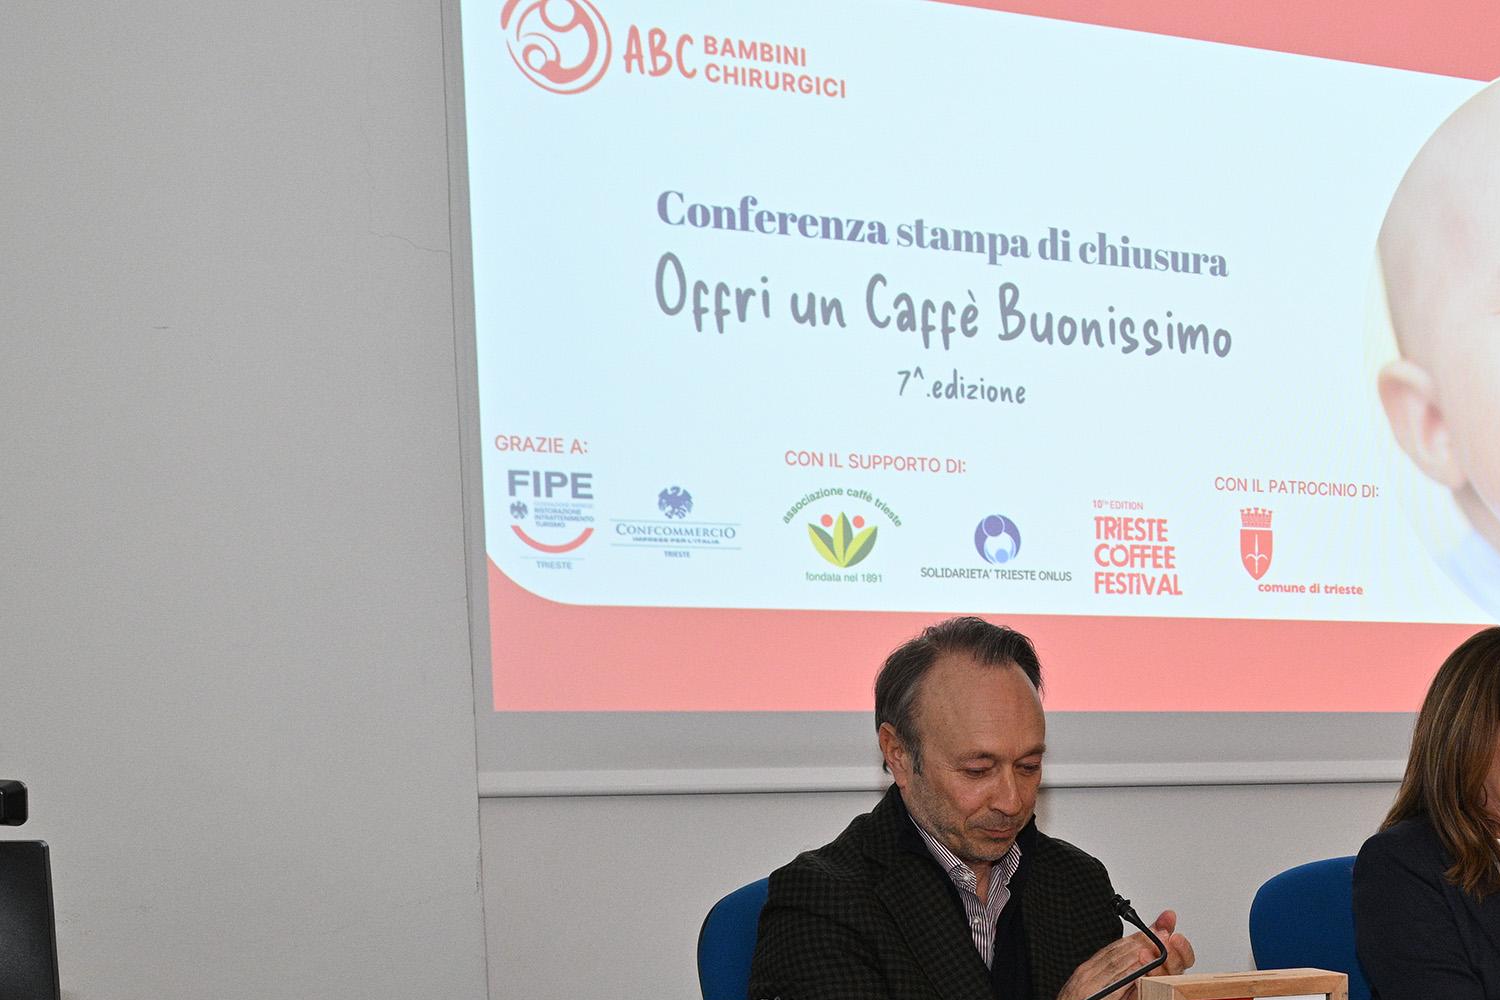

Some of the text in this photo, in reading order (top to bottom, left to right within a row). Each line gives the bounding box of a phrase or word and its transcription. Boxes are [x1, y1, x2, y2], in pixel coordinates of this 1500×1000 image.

[623, 24, 698, 80] ABC
[703, 35, 808, 67] BAMBINI
[704, 63, 847, 98] CHIRURGICI
[656, 190, 1229, 278] Conferenza stampa di chiusura
[655, 251, 1233, 358] Offri un Caffè Buonissimo
[494, 434, 588, 455] GRAZIE A:
[784, 450, 967, 474] CON IL SUPPORTO DI:
[507, 469, 594, 500] FIPE
[1214, 476, 1380, 498] CON IL PATROCINIO DI:
[782, 487, 903, 528] associazione caffè trieste
[1110, 500, 1144, 511] EDITION
[615, 522, 737, 540] CONFCOMMERCIO
[1093, 515, 1169, 542] TRIESTE
[536, 560, 573, 570] TRIESTE
[1094, 543, 1176, 569] COFFEE
[805, 571, 883, 583] fondata nel 1891
[994, 568, 1037, 581] TRIESTE
[1038, 570, 1073, 582] ONLUS
[1094, 571, 1184, 596] FESTIVAL
[1258, 583, 1364, 595] comune di trieste
